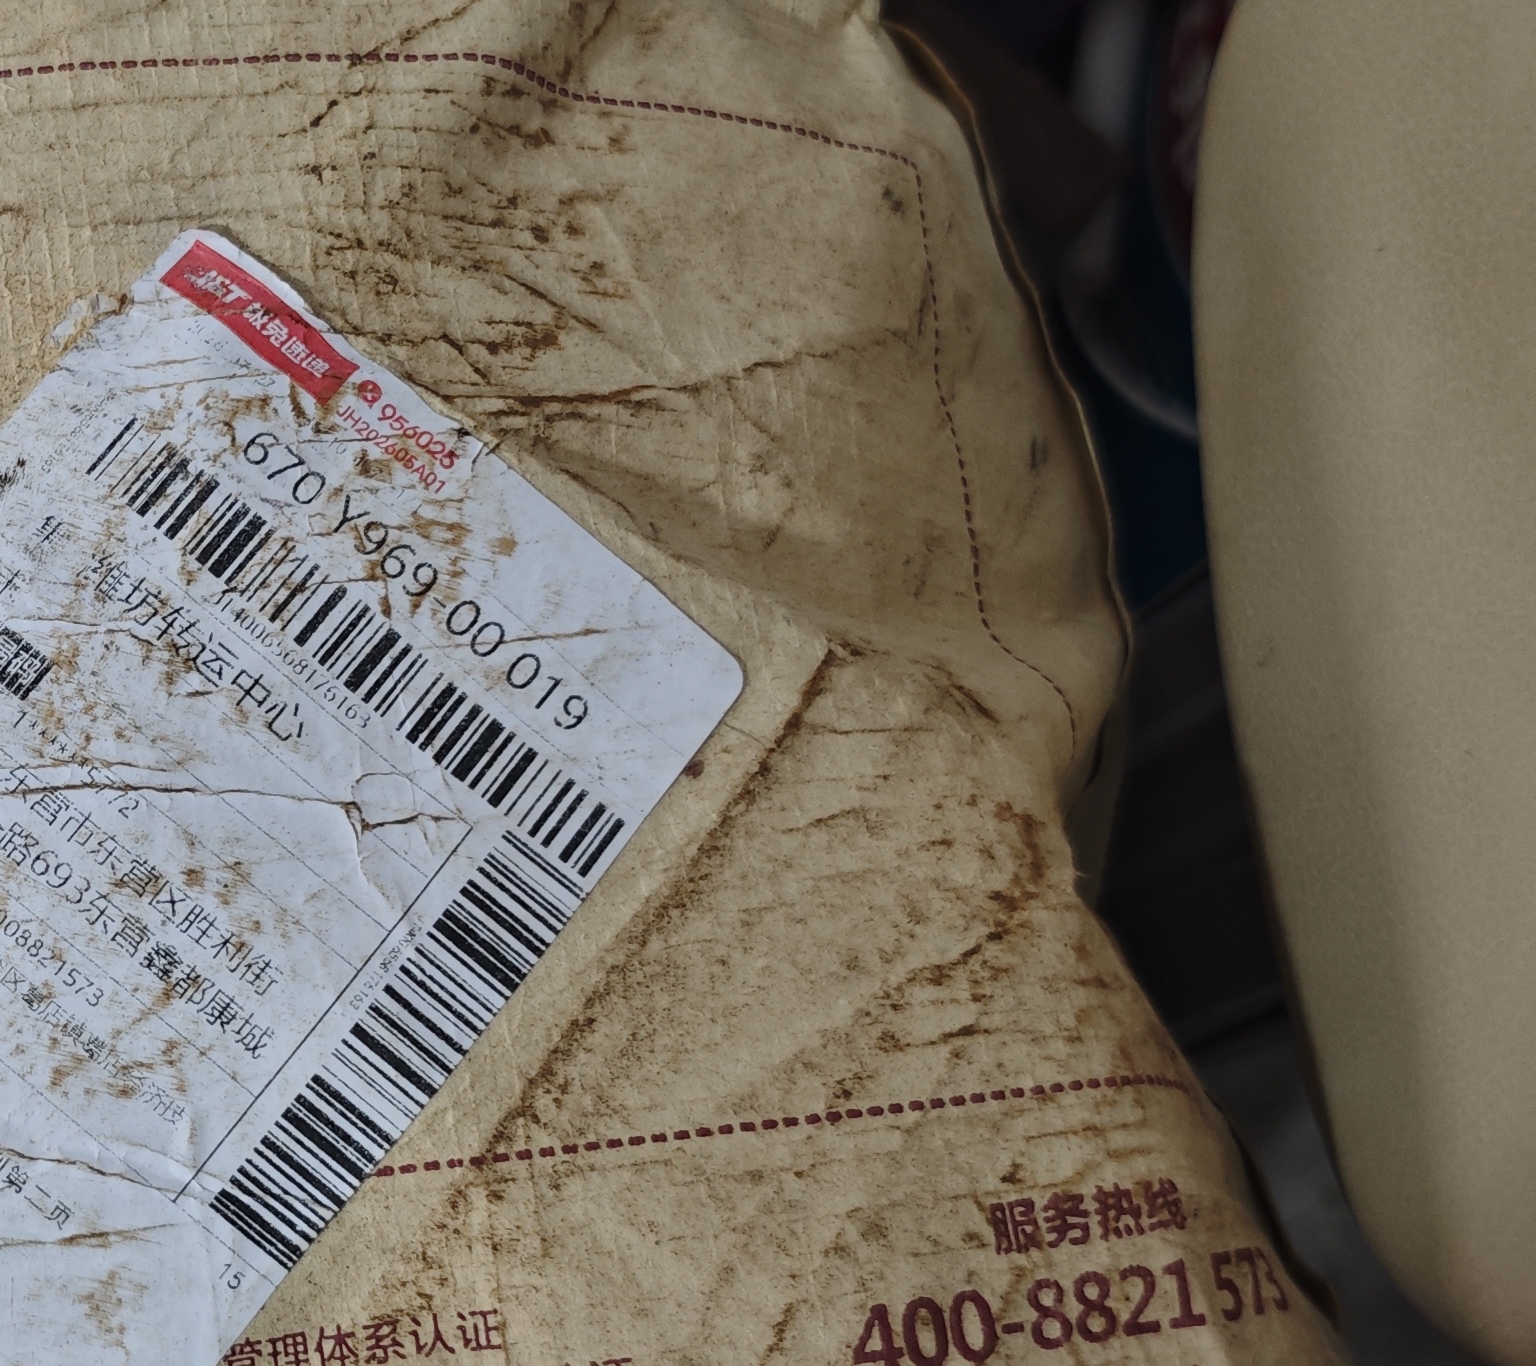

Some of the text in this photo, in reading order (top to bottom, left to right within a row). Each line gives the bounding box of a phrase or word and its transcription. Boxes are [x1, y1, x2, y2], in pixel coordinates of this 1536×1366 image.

[335, 406, 444, 493] JH202605A01
[376, 403, 459, 470] 956025
[239, 427, 591, 733] 670 Y969-00 019
[77, 545, 317, 746] 潍坊转运中心
[216, 1260, 247, 1293] 15
